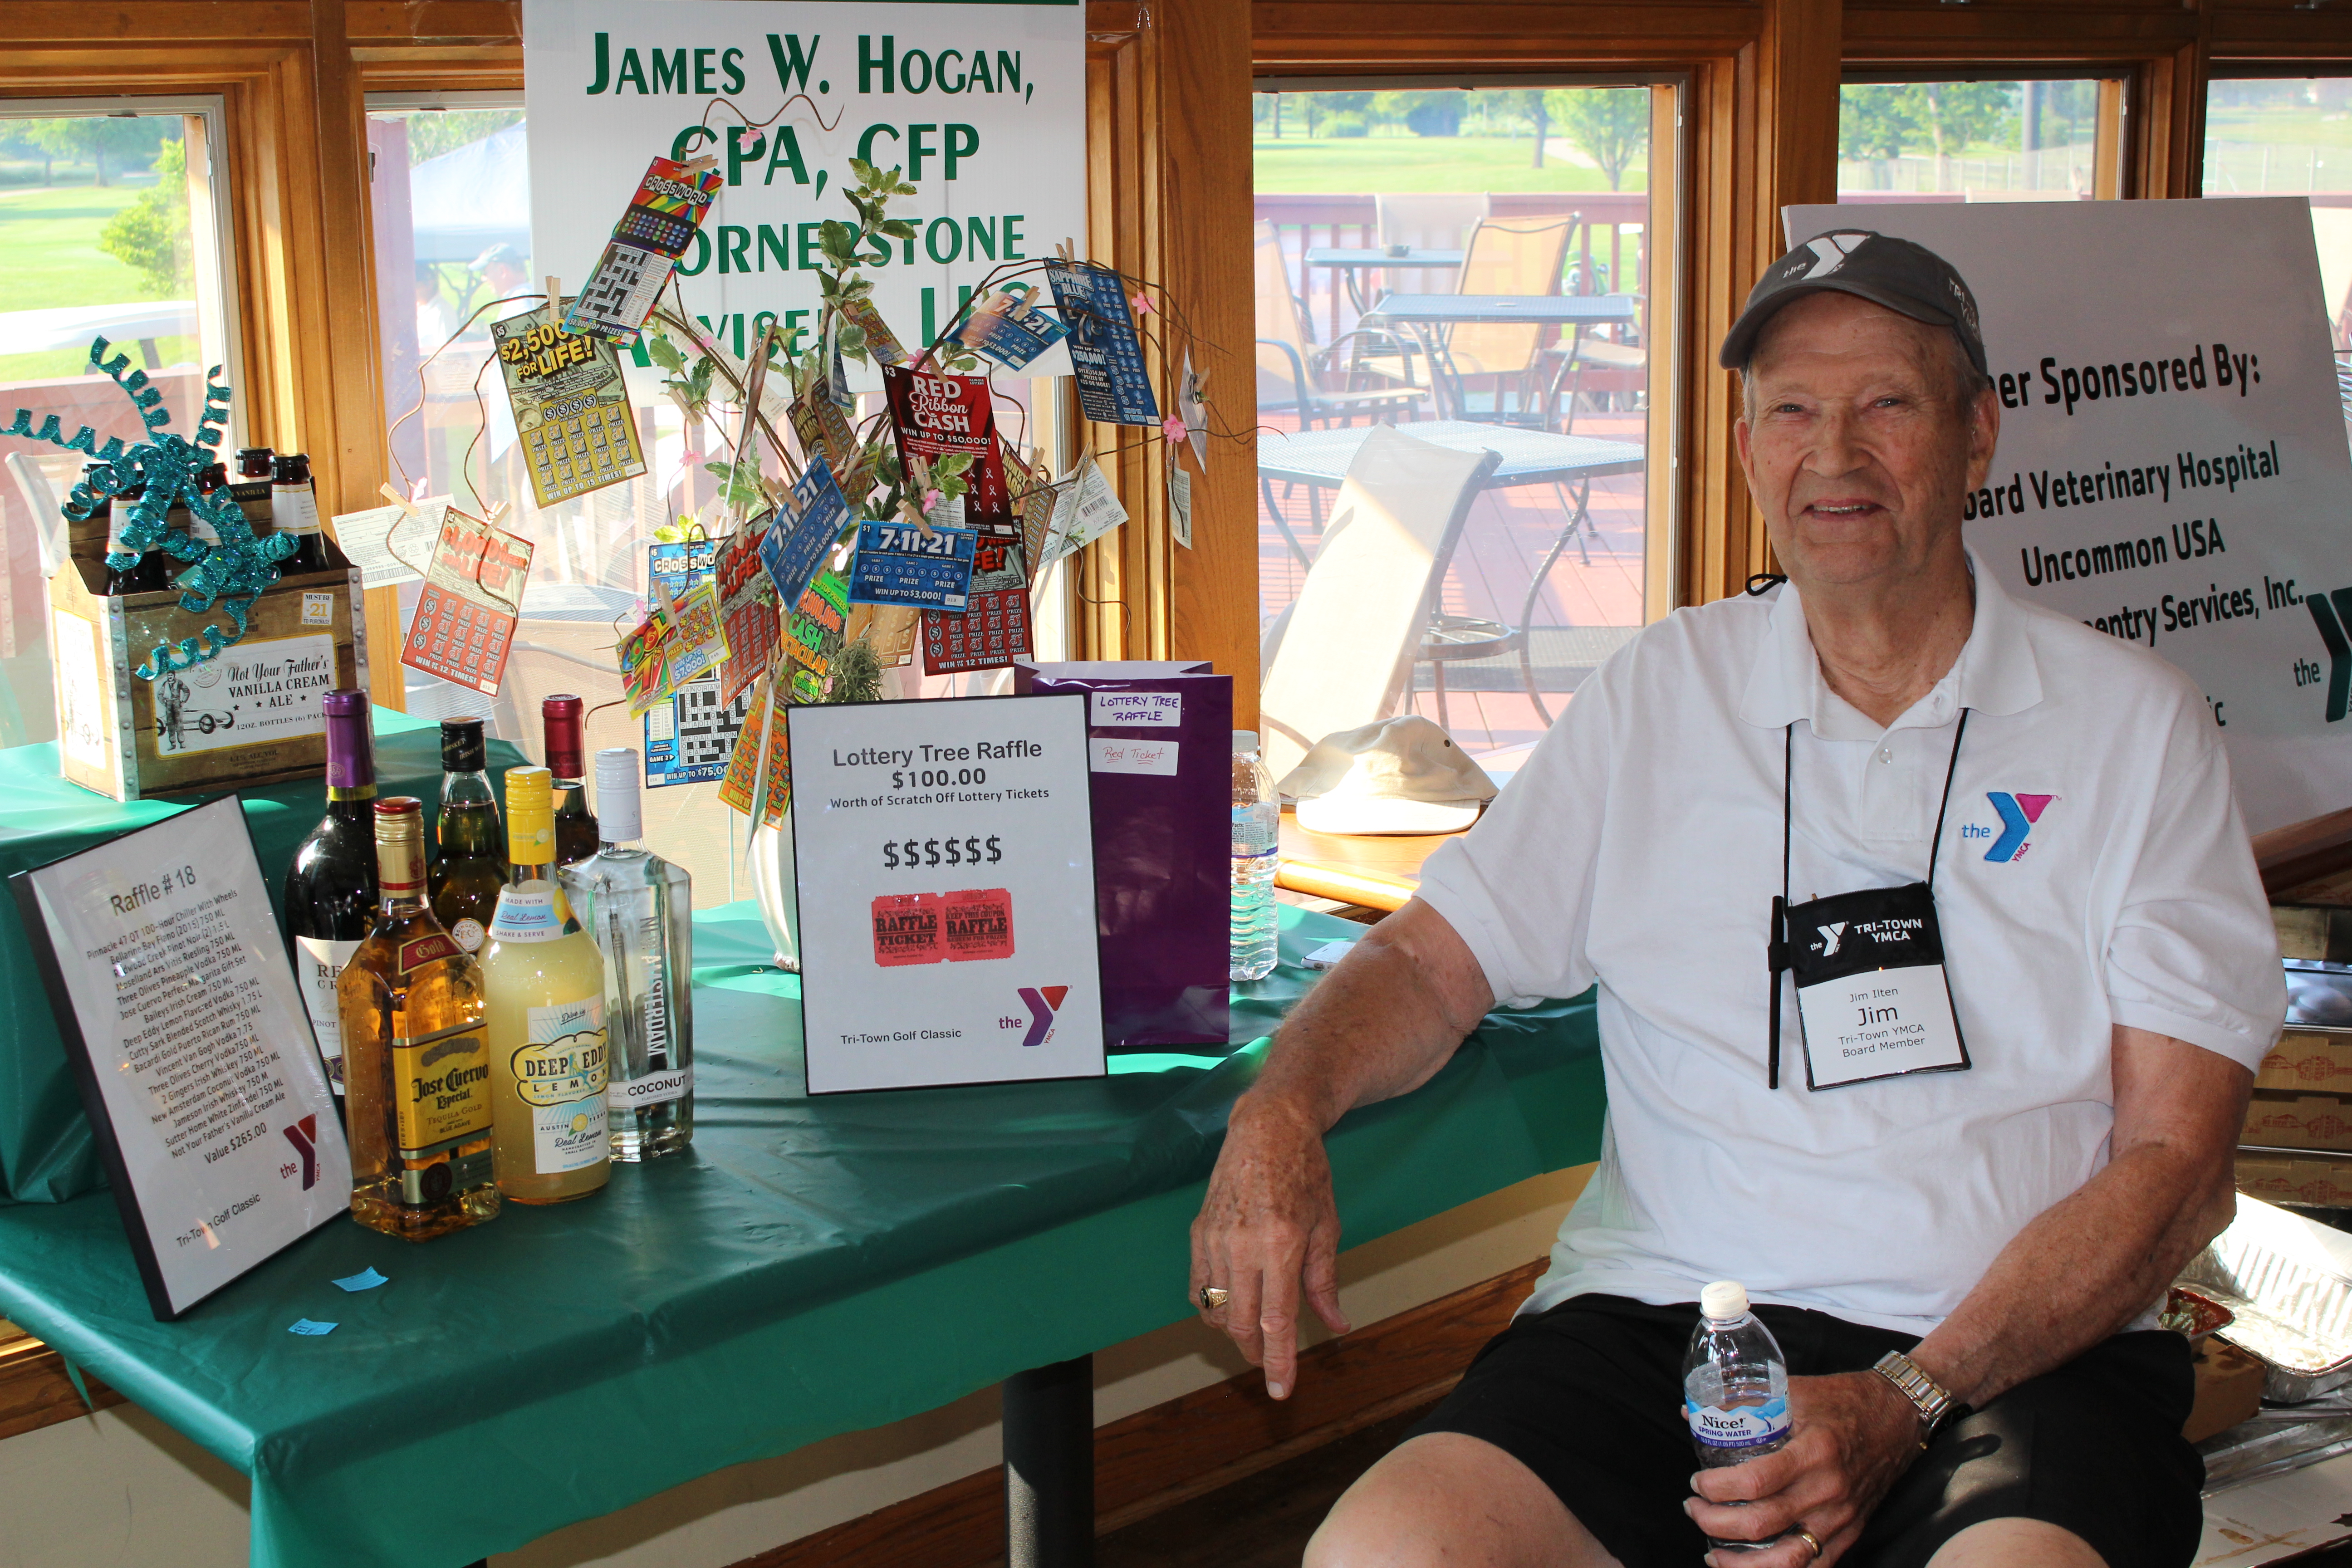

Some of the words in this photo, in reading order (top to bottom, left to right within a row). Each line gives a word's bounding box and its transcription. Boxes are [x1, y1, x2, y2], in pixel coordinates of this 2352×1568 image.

[587, 32, 746, 96] JAMES
[766, 34, 830, 94] W.
[858, 35, 1034, 105] HOGAN,
[857, 123, 980, 182] CFP
[644, 174, 710, 206] CROSSWORD
[1049, 269, 1094, 292] SAPPHIRE
[1783, 262, 1807, 279] the
[1061, 284, 1088, 300] BLUE
[589, 321, 600, 330] TOP
[601, 324, 624, 337] PRIZES!
[516, 362, 538, 379] FOR
[537, 337, 593, 376] LIFE!
[884, 366, 896, 377] $3
[2040, 344, 2207, 416] Sponsored
[2212, 343, 2260, 397] By:
[912, 376, 961, 399] RED
[909, 392, 968, 417] Ribbon
[914, 412, 970, 432] CASH
[901, 426, 919, 437] WIN
[921, 431, 931, 440] UP
[932, 433, 944, 441] TO
[947, 435, 991, 445] $50,000!
[547, 490, 561, 501] WIN
[564, 485, 574, 495] UP
[574, 483, 585, 492] TO
[587, 478, 596, 487] 15
[598, 469, 623, 484] TIMES!
[2029, 461, 2170, 510] Veterinary
[2177, 440, 2280, 493] Hospital
[2020, 534, 2168, 588] Uncommon
[2171, 517, 2225, 560] USA
[899, 577, 919, 585] PRIZE
[935, 580, 955, 588] PRIZE
[910, 591, 941, 600] $3,000!
[2161, 583, 2260, 632] Services,
[2263, 575, 2304, 610] Inc.
[228, 666, 249, 681] Not
[252, 663, 281, 682] Your
[284, 654, 329, 676] Father's
[675, 655, 706, 681] $7,000!
[2293, 657, 2321, 687] the
[229, 681, 282, 698] VANILLA
[286, 674, 330, 690] CREAM
[269, 694, 293, 708] ALE
[1100, 696, 1148, 707] LOTTERY
[1152, 696, 1179, 708] TREE
[260, 717, 294, 727] BOTTLES
[1112, 711, 1163, 721] RAFFLE
[459, 749, 474, 760] IRISH
[833, 748, 913, 768] Lottery
[919, 745, 970, 762] Tree
[977, 740, 1042, 759] Raffle
[1102, 746, 1125, 759] Red
[1131, 747, 1165, 760] Ticket
[892, 768, 986, 790] $100.00
[830, 797, 867, 808] Worth
[871, 796, 883, 806] of
[887, 794, 932, 805] Scratch
[936, 792, 955, 803] Off
[958, 790, 1002, 803] Lottery
[1006, 789, 1049, 800] Tickets
[1962, 823, 1990, 838] the
[2012, 842, 2032, 862] YMCA
[109, 882, 161, 916] Raffle
[161, 873, 174, 896] #
[176, 865, 196, 888] 18
[875, 914, 938, 933] RAFFLE
[964, 911, 979, 919] THIS
[980, 909, 1004, 917] COUPON
[86, 941, 118, 960] Pinnacle
[118, 935, 127, 946] 47
[129, 930, 140, 943] QT
[141, 916, 175, 936] 100-Hour
[175, 907, 196, 921] Chiller
[197, 899, 214, 912] With
[213, 889, 238, 905] Wheels
[946, 916, 1007, 935] RAFFLE
[1854, 919, 1923, 934] TRI-TOWN
[877, 932, 936, 946] TICKET
[1810, 942, 1823, 951] the
[1871, 930, 1911, 943] YMCA
[416, 939, 446, 958] Gold
[1849, 993, 1868, 1003] Jim
[1872, 988, 1898, 998] Ilten
[122, 1034, 142, 1049] Deep
[142, 1025, 160, 1039] Eddy
[160, 1014, 184, 1031] Lemon
[183, 998, 213, 1019] Flavored
[212, 990, 235, 1004] Vodka
[234, 981, 249, 995] 750
[249, 976, 260, 988] ML
[641, 955, 667, 1057] AMSTERDAM
[1858, 1006, 1898, 1026] Jim
[313, 1019, 337, 1028] PINOT
[999, 1016, 1022, 1029] the
[840, 1034, 890, 1045] Tri-Town
[893, 1031, 916, 1041] Golf
[920, 1029, 962, 1040] Classic
[1044, 1028, 1056, 1044] YMCA
[1838, 1029, 1888, 1045] Tri-Town
[1891, 1024, 1925, 1036] YMCA
[155, 1058, 183, 1077] Vincent
[182, 1052, 198, 1063] Van
[197, 1041, 216, 1056] Gogh
[215, 1032, 237, 1047] Vodka
[236, 1021, 253, 1036] 7.75
[1842, 1044, 1875, 1058] Board
[1880, 1037, 1926, 1051] Member
[525, 1057, 568, 1077] DEEP
[582, 1041, 608, 1069] EDDY
[411, 1078, 444, 1103] Jose
[446, 1063, 489, 1092] Cuervo
[534, 1069, 607, 1092] LEMON
[628, 1074, 686, 1097] COCONUT
[426, 1110, 460, 1125] TEQUILA
[461, 1103, 482, 1115] GOLD
[540, 1123, 569, 1131] AUSTIN
[589, 1111, 606, 1122] TEXAS
[439, 1124, 453, 1134] BLUE
[453, 1119, 471, 1130] AGAVE
[203, 1145, 230, 1164] Value
[229, 1122, 267, 1152] $265.00
[554, 1135, 576, 1148] Real
[578, 1129, 602, 1143] Lemon
[280, 1162, 298, 1179] the
[213, 1208, 230, 1226] Golf
[231, 1194, 261, 1215] Classic
[1698, 1426, 1723, 1437] SPRING
[1725, 1429, 1752, 1437] WATER
[1701, 1414, 1744, 1429] Nice!
